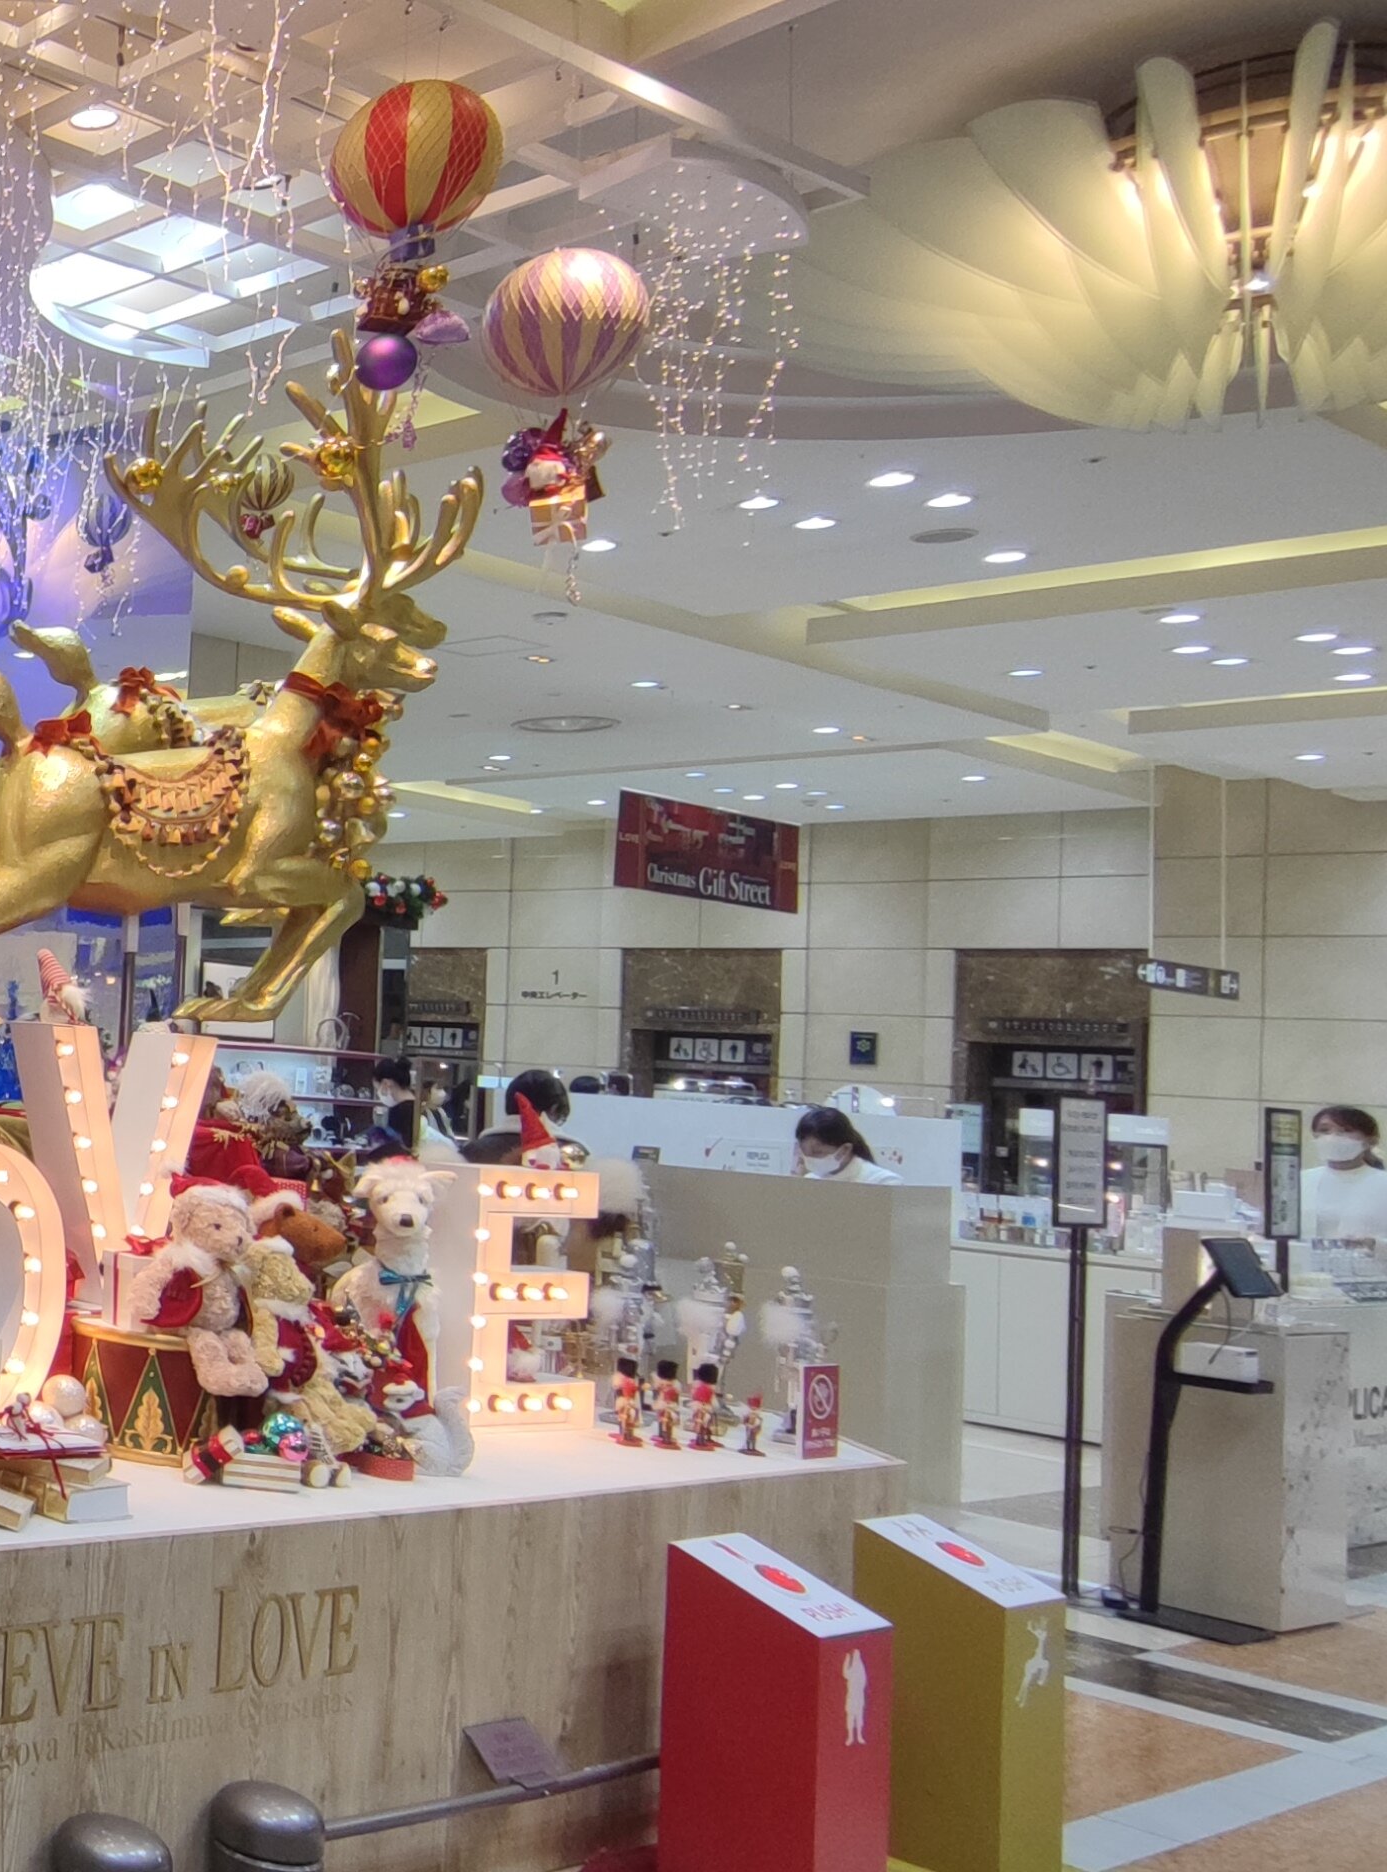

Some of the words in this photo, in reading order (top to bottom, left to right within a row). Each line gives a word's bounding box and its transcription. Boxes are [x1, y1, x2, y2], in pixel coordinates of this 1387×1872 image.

[647, 862, 697, 890] Christmas
[699, 866, 726, 898] Gift
[729, 871, 772, 906] Street
[551, 968, 560, 985] 1
[800, 1602, 858, 1622] PUSH!
[209, 1585, 361, 1694] LOVE
